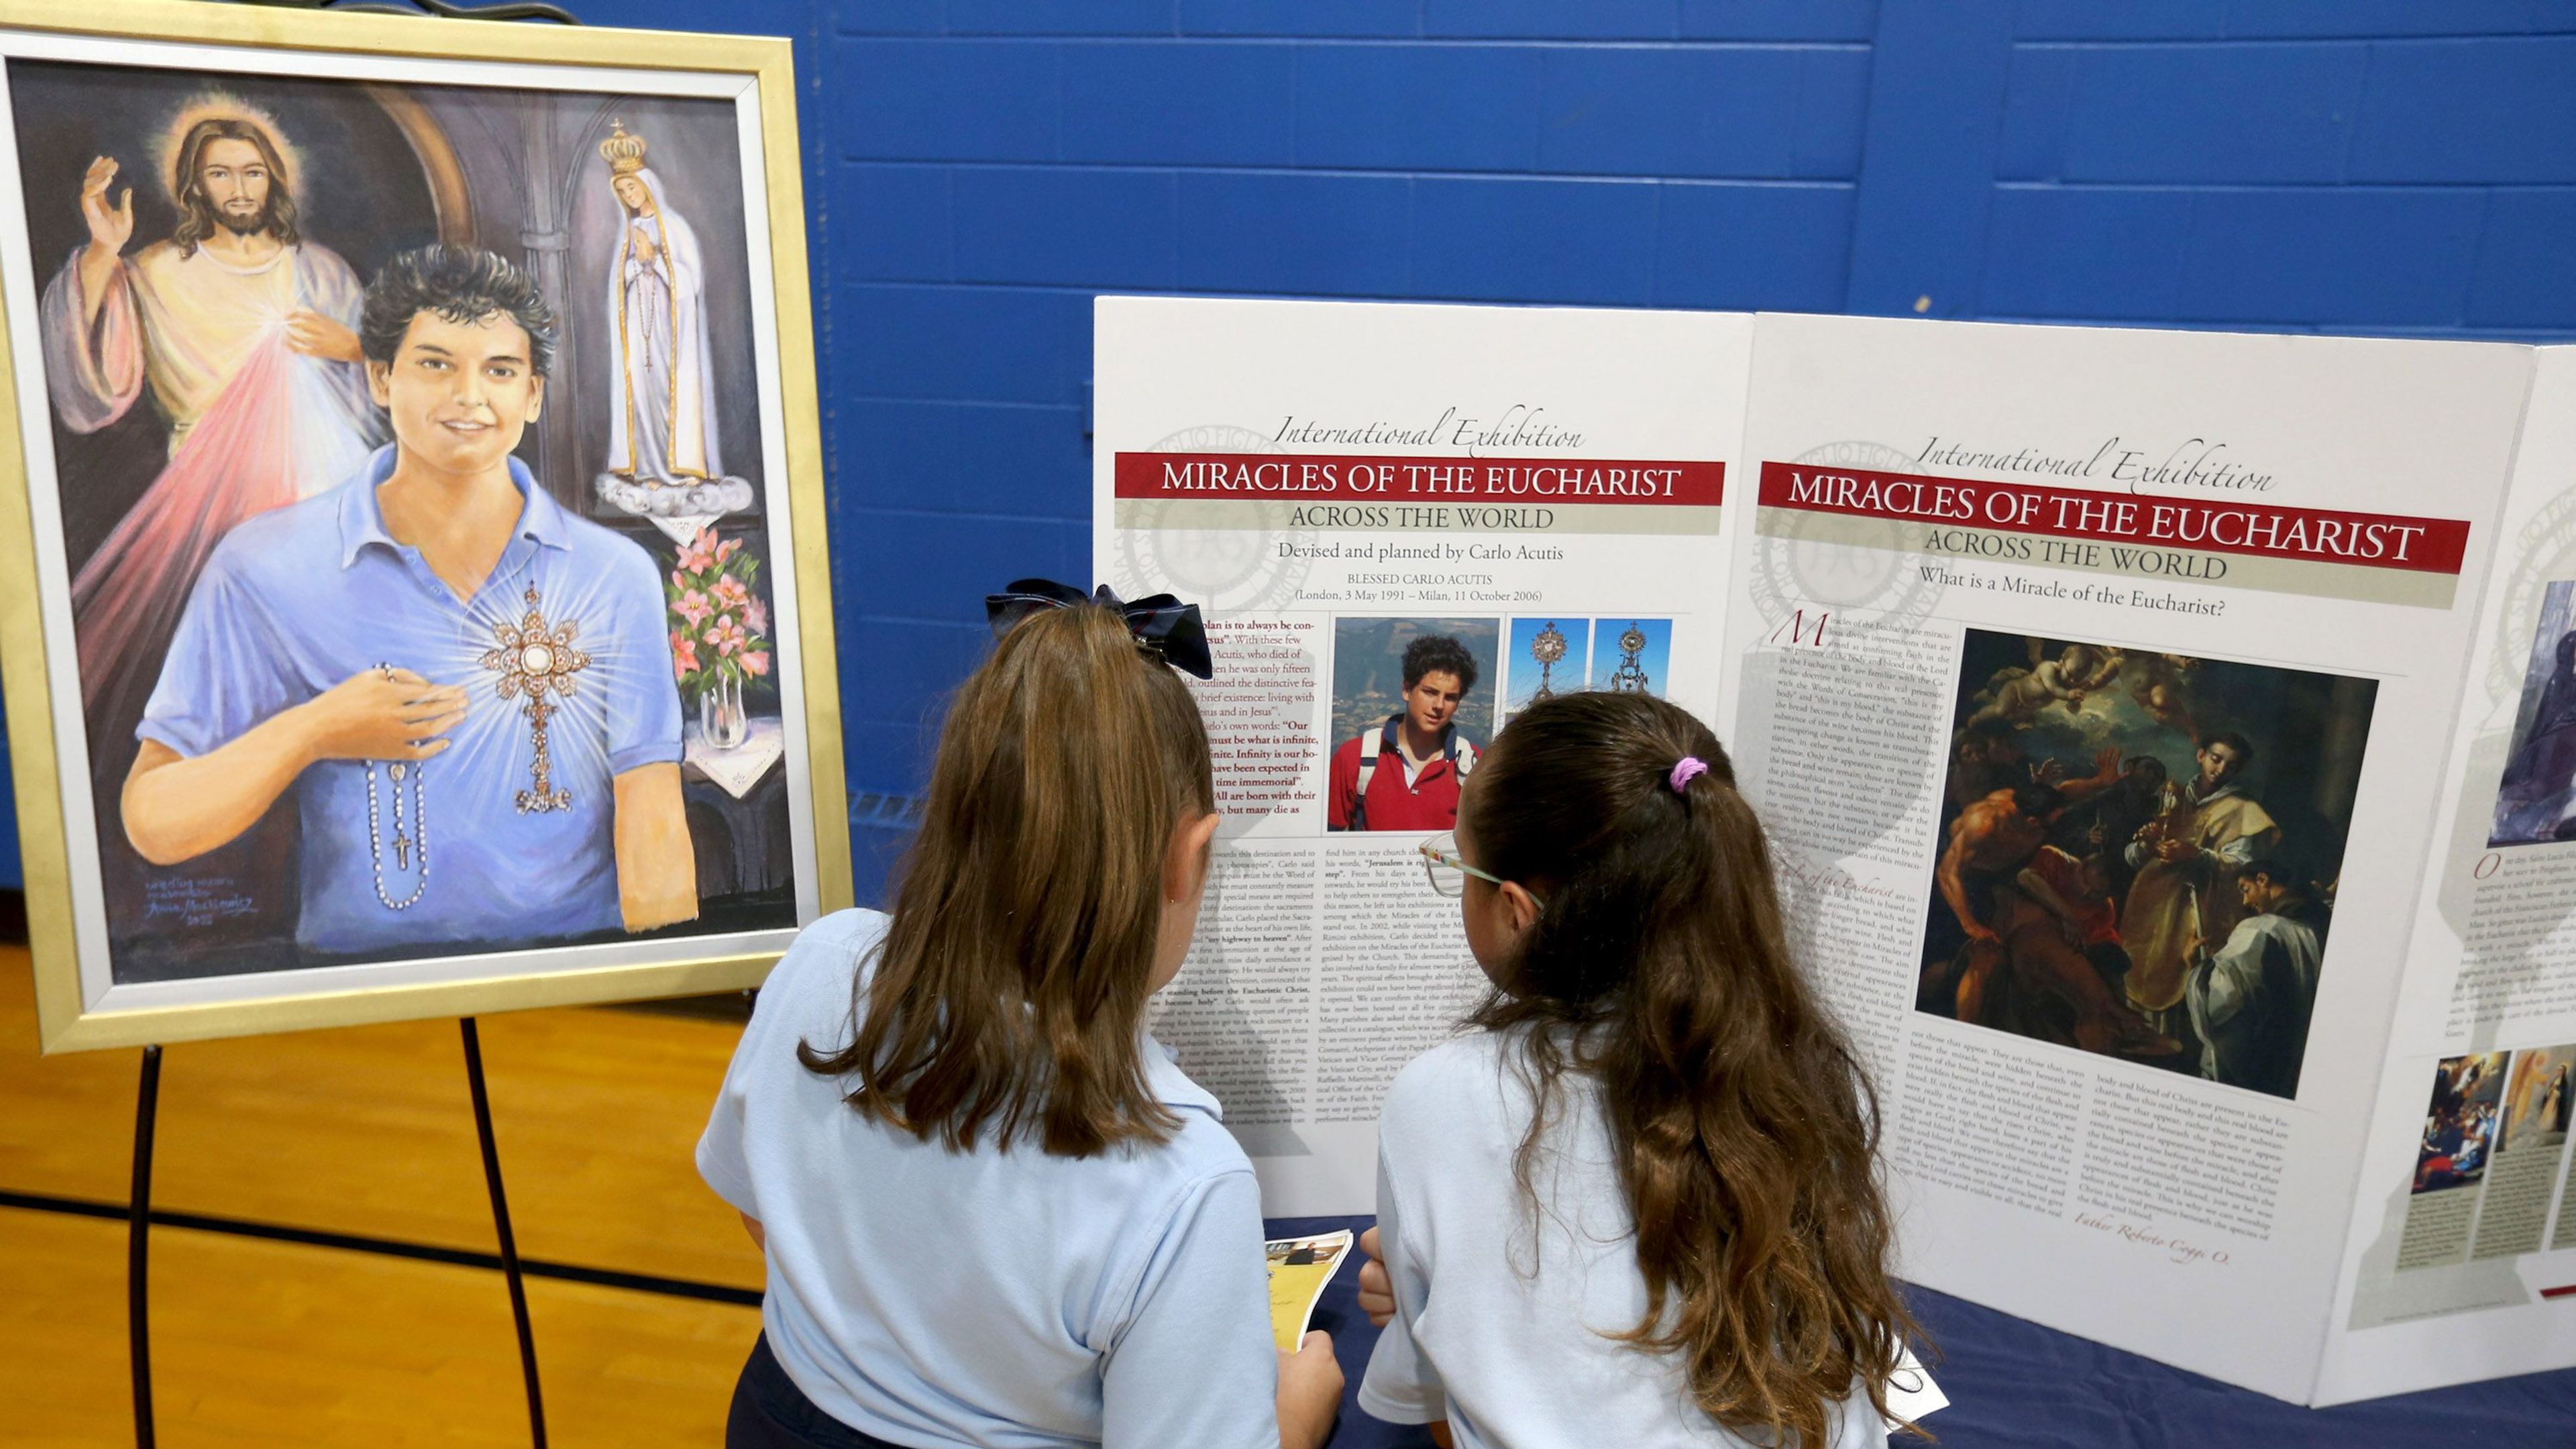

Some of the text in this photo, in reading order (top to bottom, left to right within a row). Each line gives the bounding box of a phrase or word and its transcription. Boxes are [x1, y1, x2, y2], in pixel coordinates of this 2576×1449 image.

[1274, 407, 1456, 446] International
[1452, 405, 1585, 459] Exhibition
[1917, 436, 2118, 477] International
[2111, 438, 2277, 495] Exhibition
[1161, 462, 1682, 496] MIRACLES OF THE EUCHARIST
[1289, 506, 1554, 529] ACROSS THE WORLD
[1788, 472, 2425, 561] MIRACLES OF THE EUCHARIST
[1278, 542, 1563, 564] Devised and planned by Carlo Acutis
[1924, 529, 2227, 580] ACROSS THE WORLD
[1348, 574, 1493, 585] BLESSED CARLO ACUTIS
[1295, 589, 1342, 601] (London,
[1345, 591, 1352, 600] 3
[1354, 590, 1377, 602] May
[1381, 590, 1405, 600] 1991
[1418, 590, 1451, 601] Milan,
[1455, 591, 1465, 601] 11
[1469, 590, 1510, 601] October
[1513, 590, 1542, 602] 2006)
[1919, 566, 2225, 616] What is a Miracle of the Eucharist?
[1224, 621, 1232, 629] is
[1246, 620, 1277, 632] always
[1280, 620, 1291, 629] be
[1234, 634, 1258, 644] With
[1260, 635, 1283, 644] these
[1285, 635, 1301, 644] few
[1214, 649, 1301, 659] Acutis, who died of
[1229, 663, 1240, 673] he
[1260, 663, 1281, 676] only
[1283, 663, 1310, 673] fifteen
[1198, 678, 1317, 688] outlined the distinctive fea-
[1201, 692, 1314, 704] brief existence: living with
[1219, 706, 1236, 716] and
[1238, 707, 1248, 716] in
[1250, 720, 1280, 730] words:
[1283, 720, 1308, 730] “Our
[1234, 735, 1245, 744] be
[1247, 735, 1270, 744] what
[1273, 735, 1280, 744] is
[1283, 735, 1318, 745] infinite,
[1236, 749, 1272, 761] Infinity
[1274, 749, 1281, 758] is
[1302, 749, 1318, 758] ho-
[1234, 763, 1255, 772] been
[1258, 763, 1298, 775] expected
[1300, 763, 1309, 771] in
[1216, 777, 1236, 786] time
[1246, 791, 1268, 800] born
[1271, 790, 1291, 800] with
[1294, 790, 1316, 800] their
[1227, 805, 1243, 814] but
[1246, 808, 1272, 816] many
[1274, 804, 1288, 813] die
